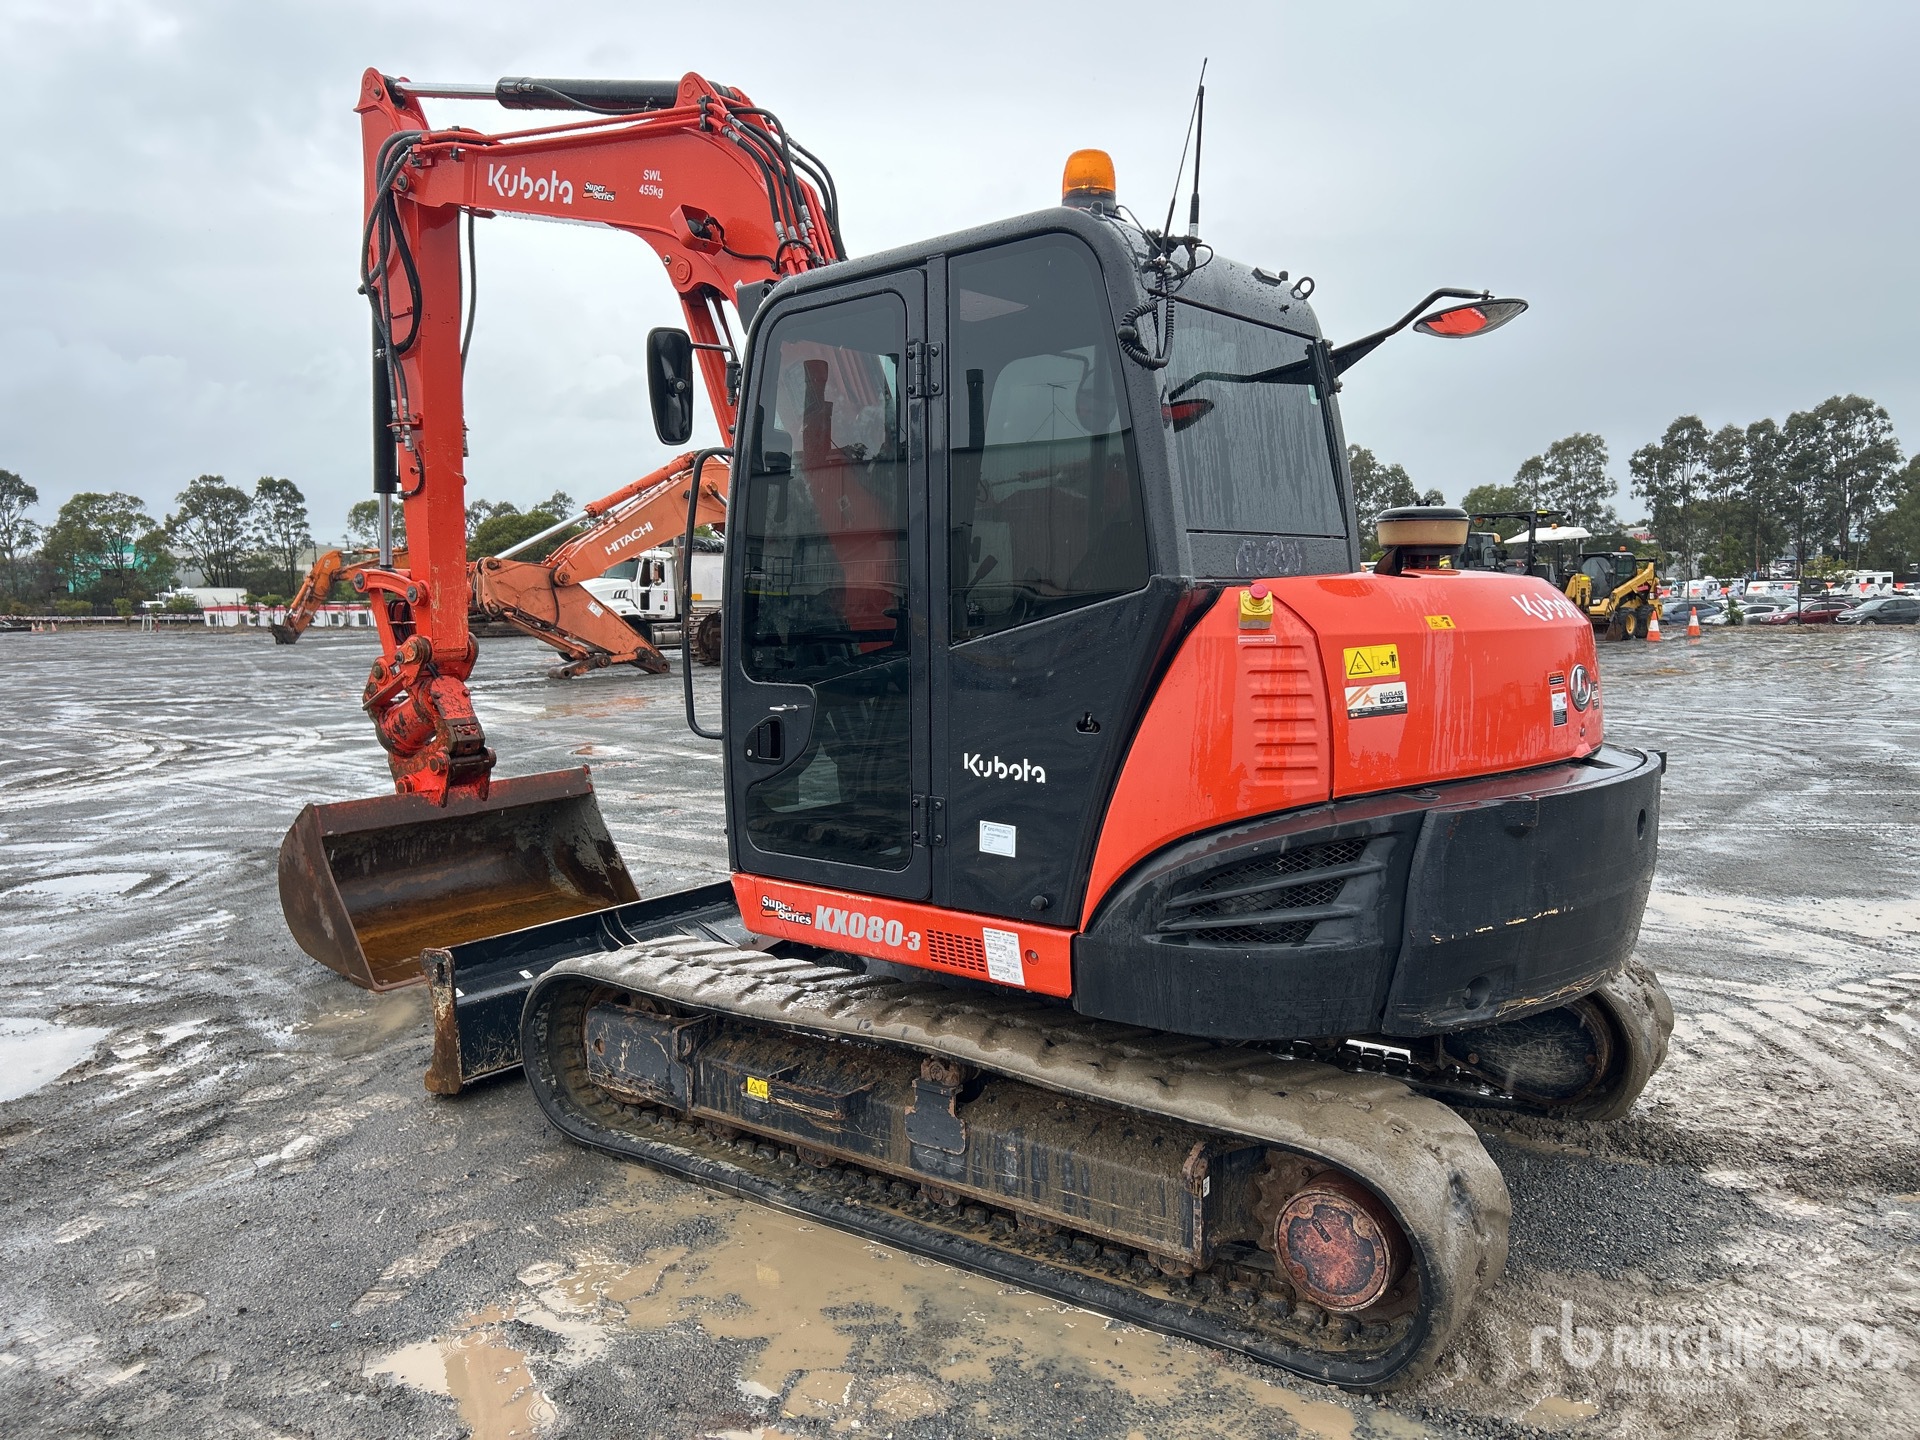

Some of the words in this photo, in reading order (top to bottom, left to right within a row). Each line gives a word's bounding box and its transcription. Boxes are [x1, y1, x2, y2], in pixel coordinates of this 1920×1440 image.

[643, 169, 662, 181] SWL
[488, 163, 574, 205] Kubota
[584, 181, 605, 193] Super
[638, 184, 664, 199] 455kg
[593, 191, 615, 202] Series
[604, 521, 654, 556] HITACHI
[1379, 689, 1404, 698] ALLCLASS
[963, 752, 1046, 784] Kubota
[777, 909, 812, 925] Series
[814, 905, 921, 951] KX080-3
